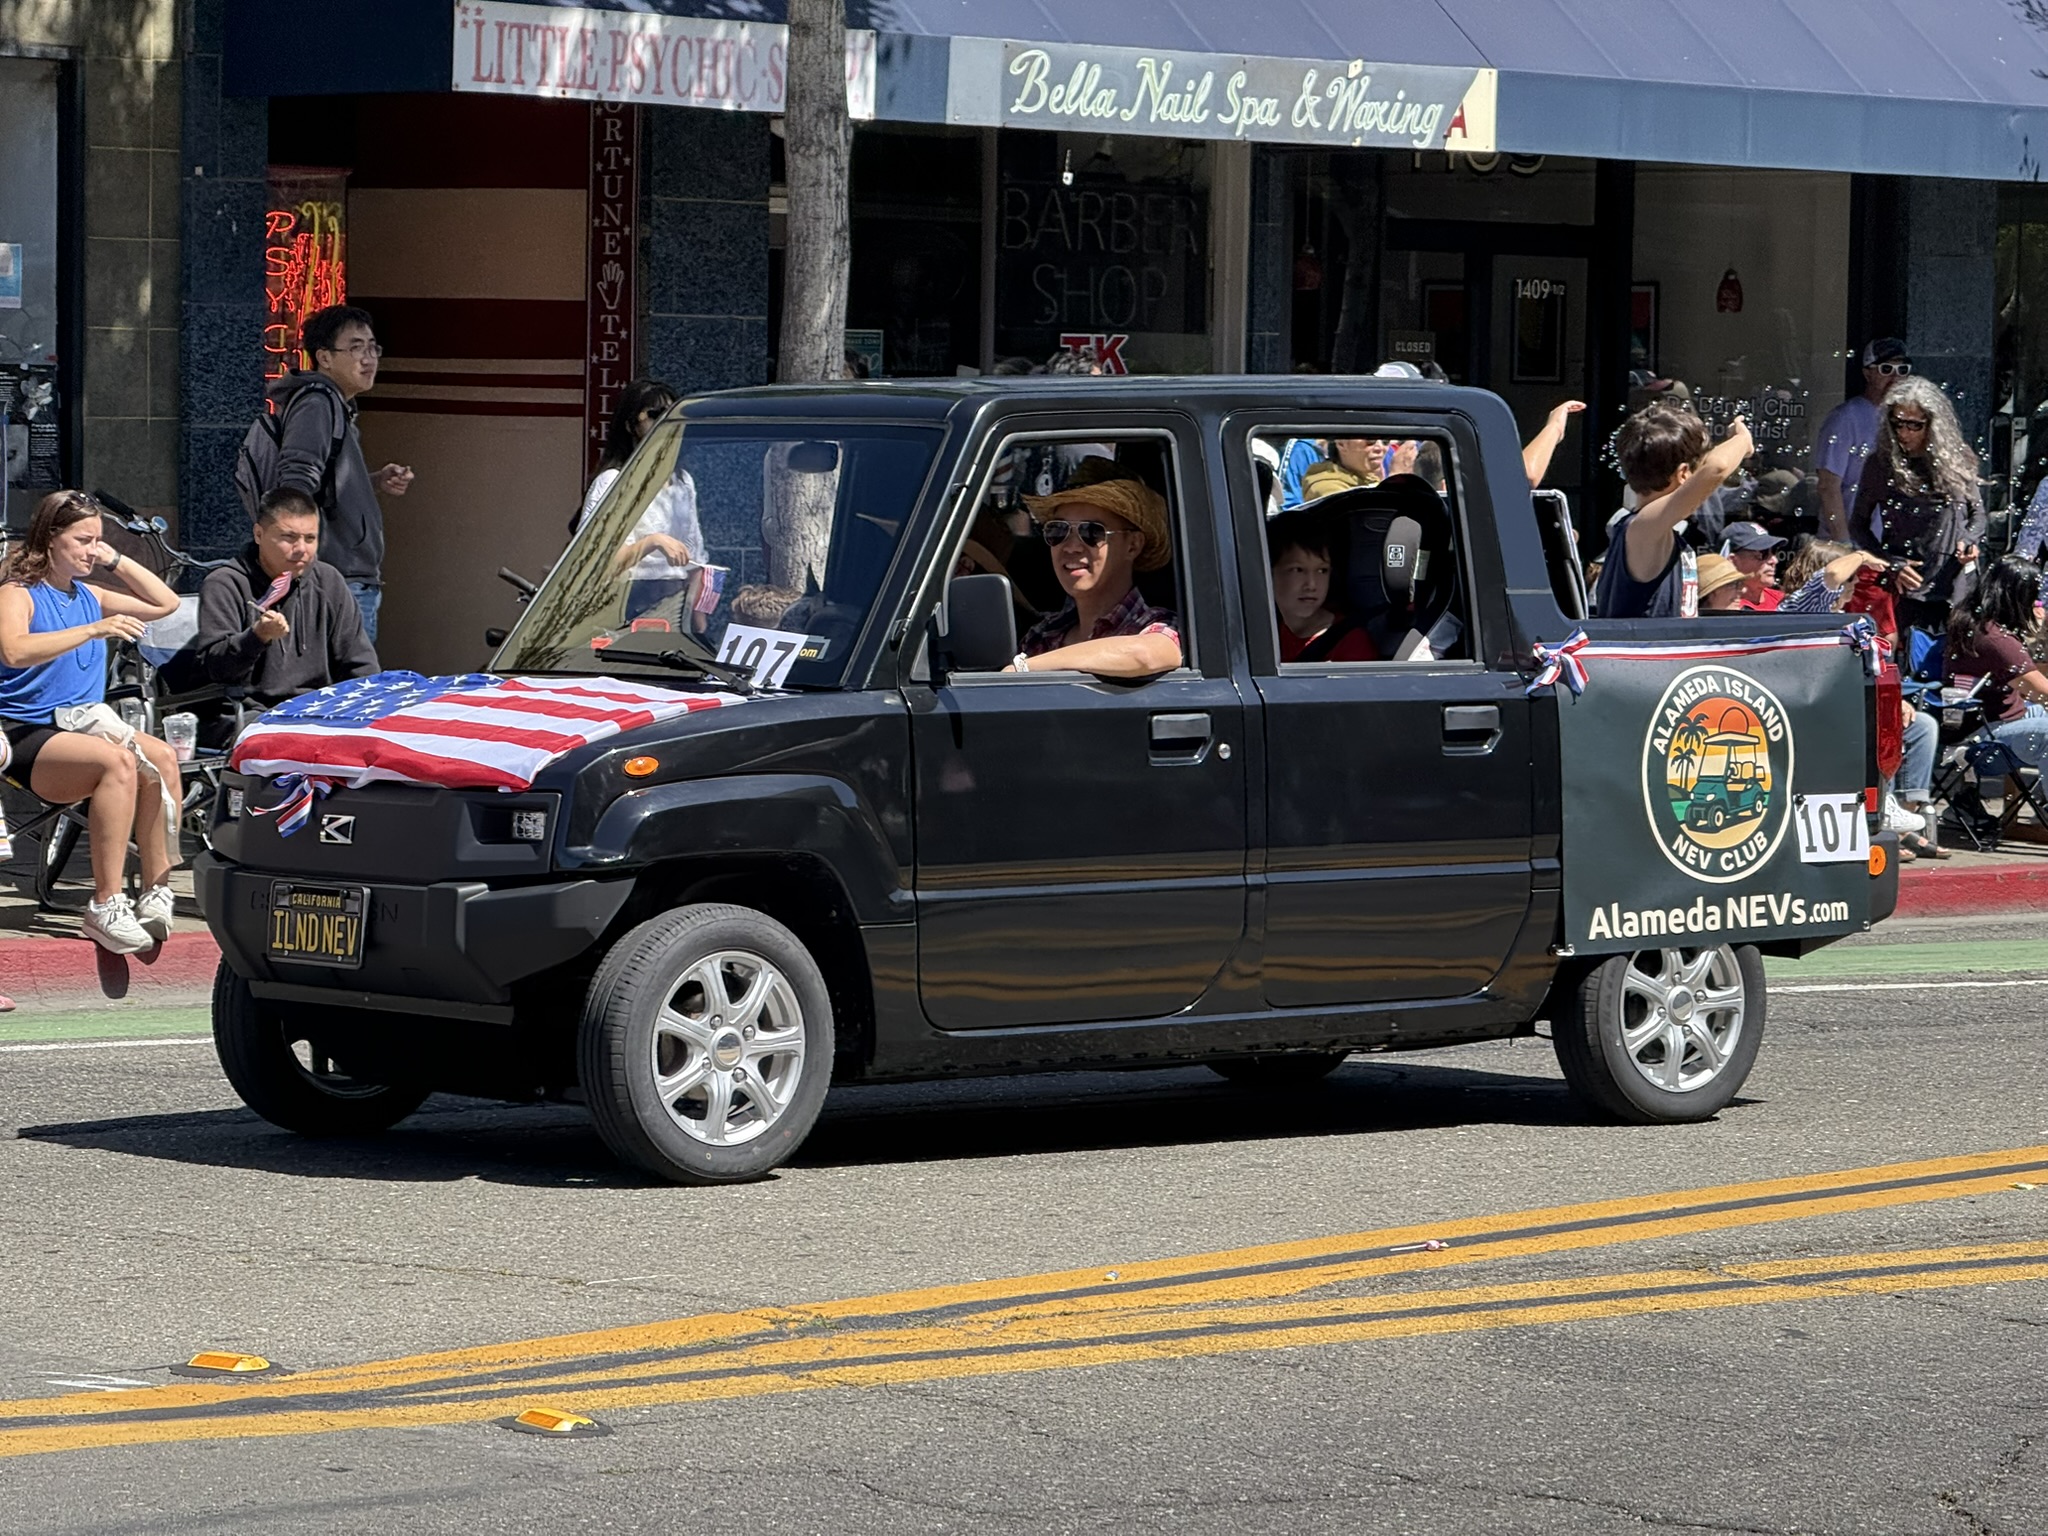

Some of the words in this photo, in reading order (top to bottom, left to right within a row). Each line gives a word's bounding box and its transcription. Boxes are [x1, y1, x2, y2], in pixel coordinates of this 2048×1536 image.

[472, 18, 598, 90] LITTLE
[607, 29, 757, 100] PSYCHIC
[1009, 49, 1120, 118] Bella
[1120, 58, 1215, 123] Nail
[1218, 70, 1281, 137] Spa
[1291, 68, 1322, 128] &
[1326, 75, 1443, 149] Waxing
[1002, 187, 1198, 255] BARBER
[1033, 263, 1167, 327] SHOP
[1516, 279, 1550, 299] 1409
[1395, 341, 1431, 353] CLOSED
[1764, 398, 1805, 418] Chin
[1652, 674, 1721, 755] ALAMEDA
[1726, 676, 1784, 743] ISLAND
[1672, 834, 1712, 870] NEV
[1720, 831, 1768, 872] CLUB
[1800, 803, 1860, 853] 107
[292, 893, 341, 909] CALIFORNIA
